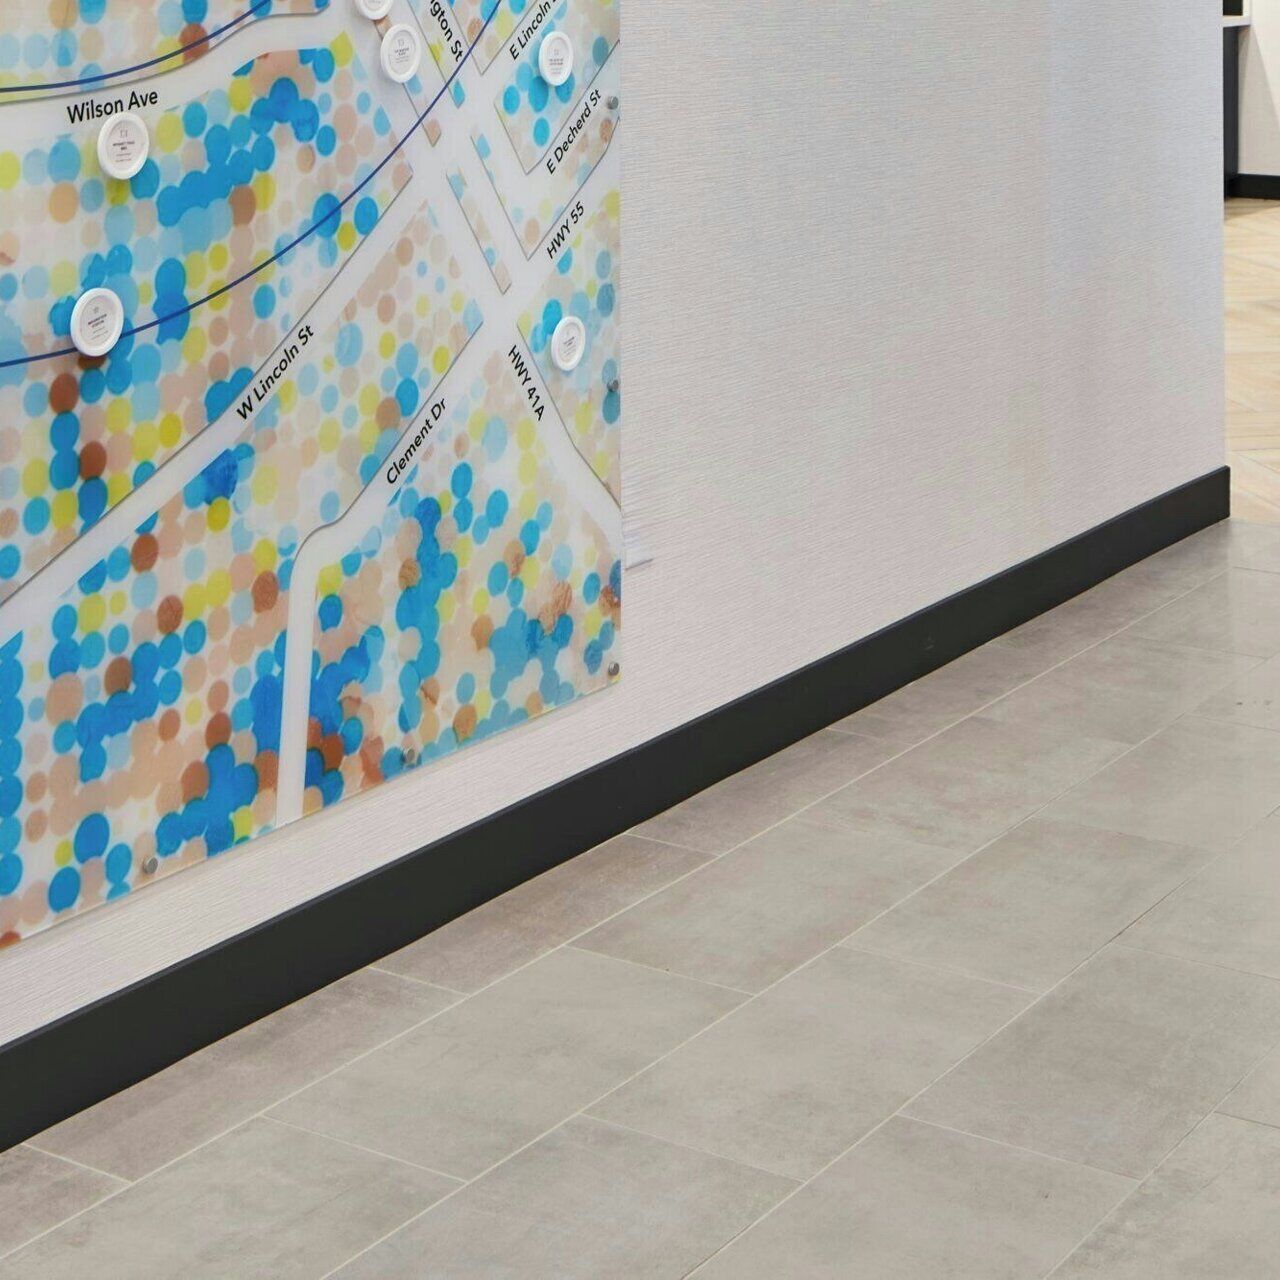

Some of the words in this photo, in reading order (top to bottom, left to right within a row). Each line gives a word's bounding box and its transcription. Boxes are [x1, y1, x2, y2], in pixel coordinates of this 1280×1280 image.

[450, 42, 464, 62] St
[509, 46, 520, 61] E
[517, 2, 552, 48] Lincoln
[67, 98, 124, 124] Wilson
[128, 90, 159, 111] Ave
[545, 160, 556, 175] E
[554, 107, 592, 161] Decherd
[588, 88, 602, 109] St
[546, 220, 573, 260] HWY
[569, 201, 586, 226] 55
[235, 400, 255, 423] W
[250, 343, 301, 403] Lincoln
[297, 324, 316, 347] St
[508, 345, 536, 389] HWY
[526, 386, 546, 422] 41A
[386, 414, 439, 485] Clement
[431, 397, 449, 422] Dr
